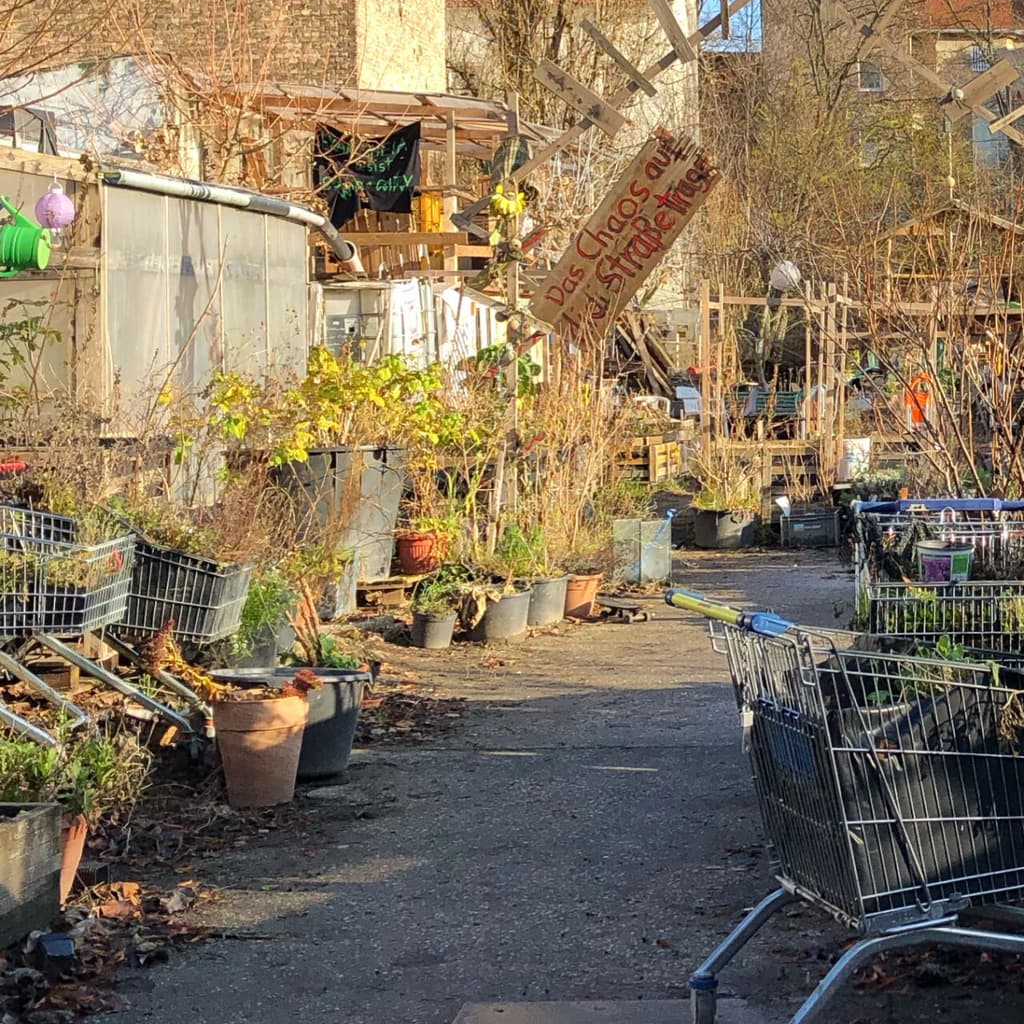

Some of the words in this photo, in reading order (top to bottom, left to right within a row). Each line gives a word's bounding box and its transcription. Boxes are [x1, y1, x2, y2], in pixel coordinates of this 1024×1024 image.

[544, 263, 585, 306] Das
[576, 179, 650, 261] Chaos
[595, 211, 676, 293] Straße
